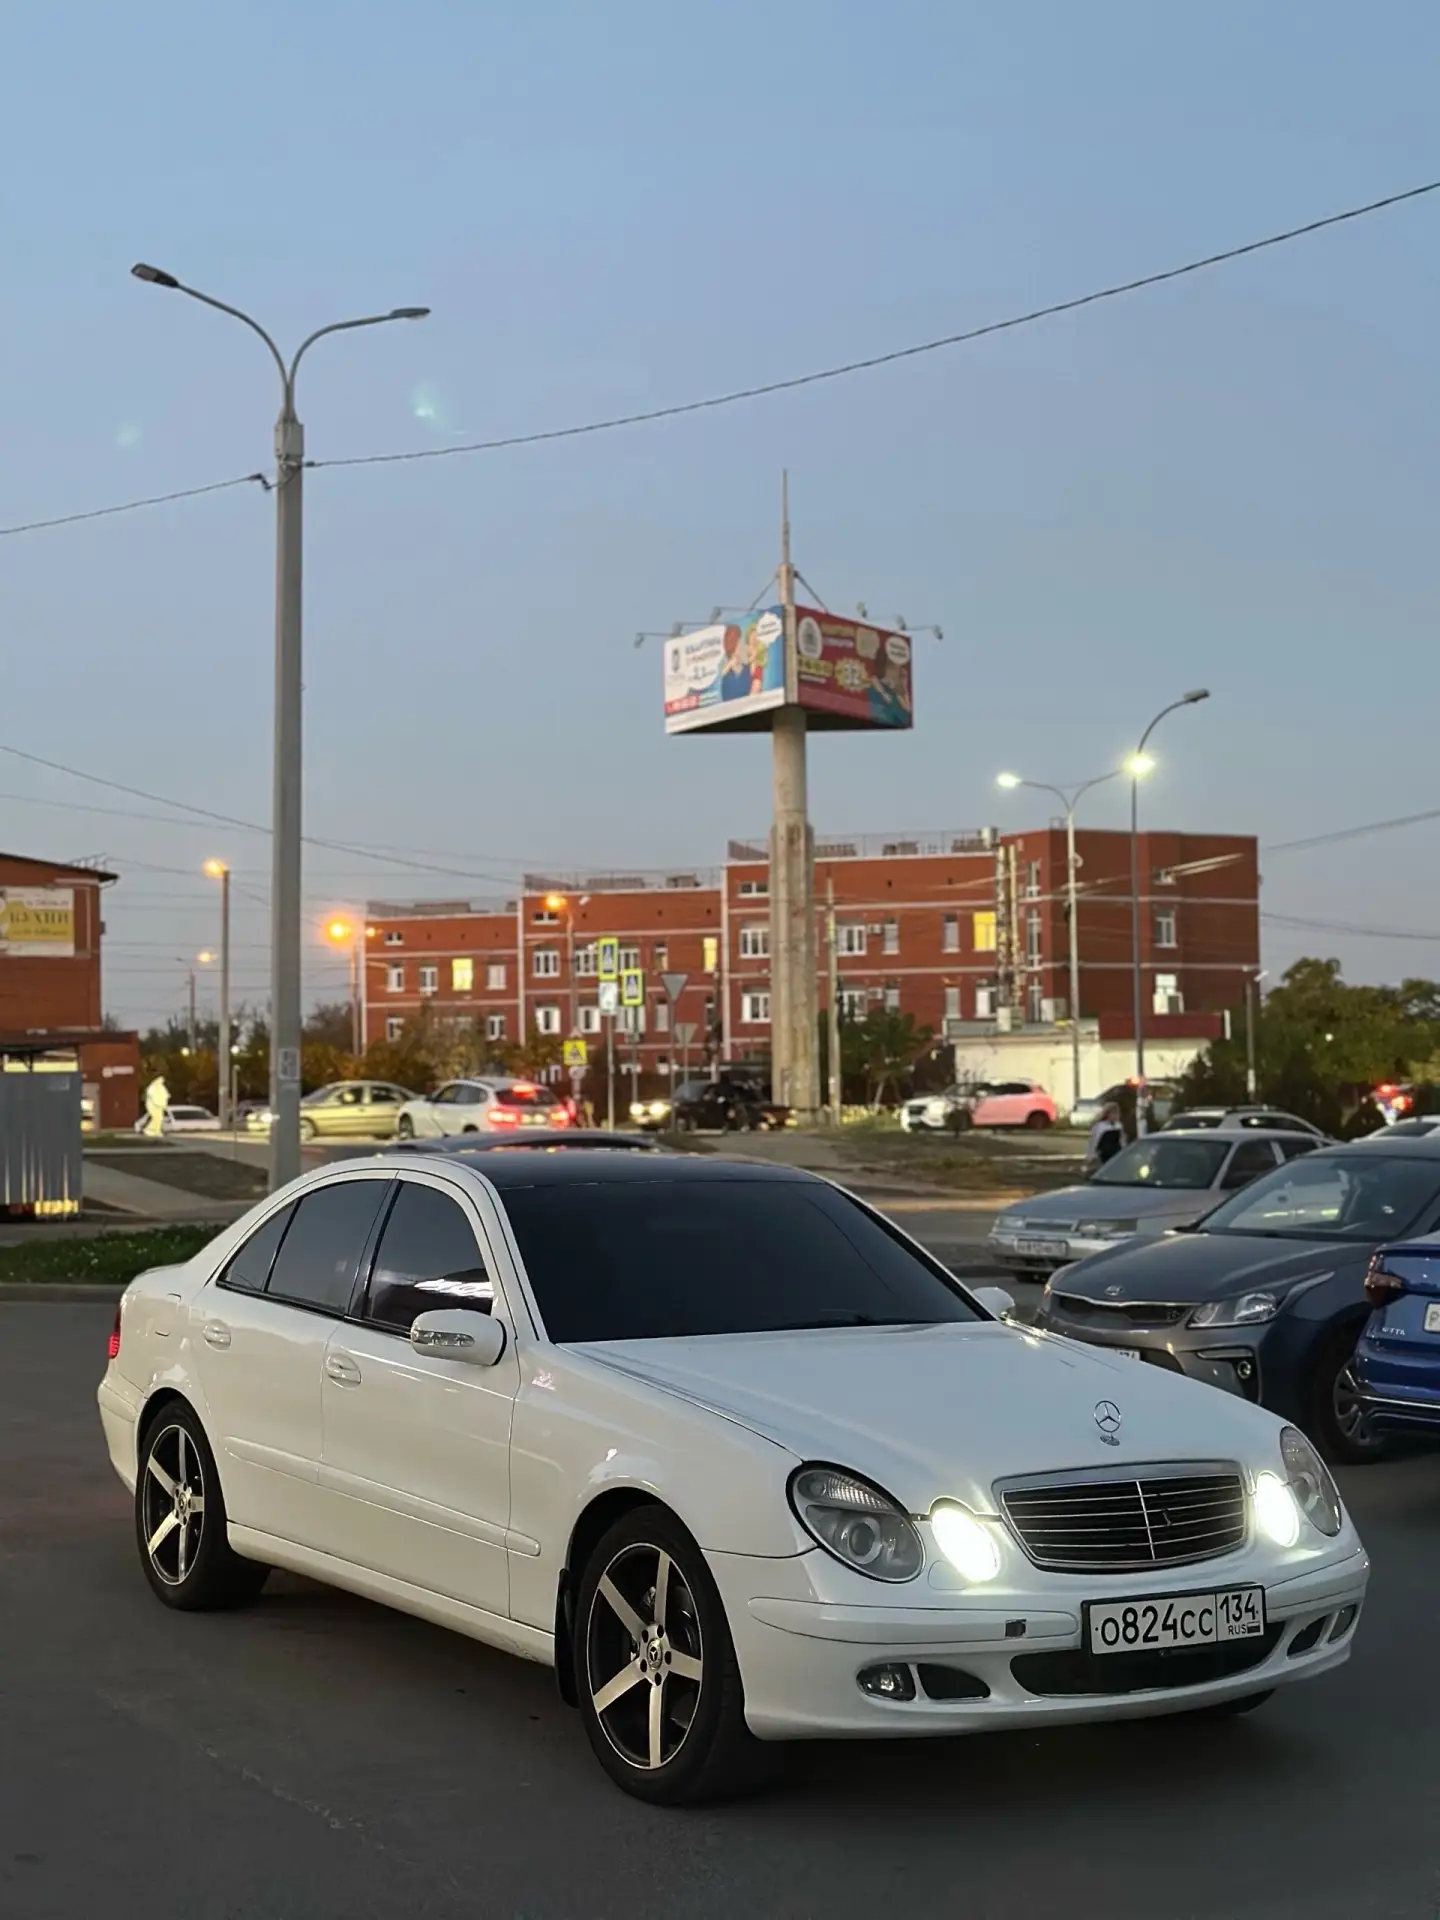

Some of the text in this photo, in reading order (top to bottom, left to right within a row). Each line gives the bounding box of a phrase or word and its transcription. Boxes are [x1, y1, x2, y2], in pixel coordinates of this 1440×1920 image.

[1100, 1592, 1256, 1646] О824СС 134
[1227, 1623, 1247, 1636] RUS
